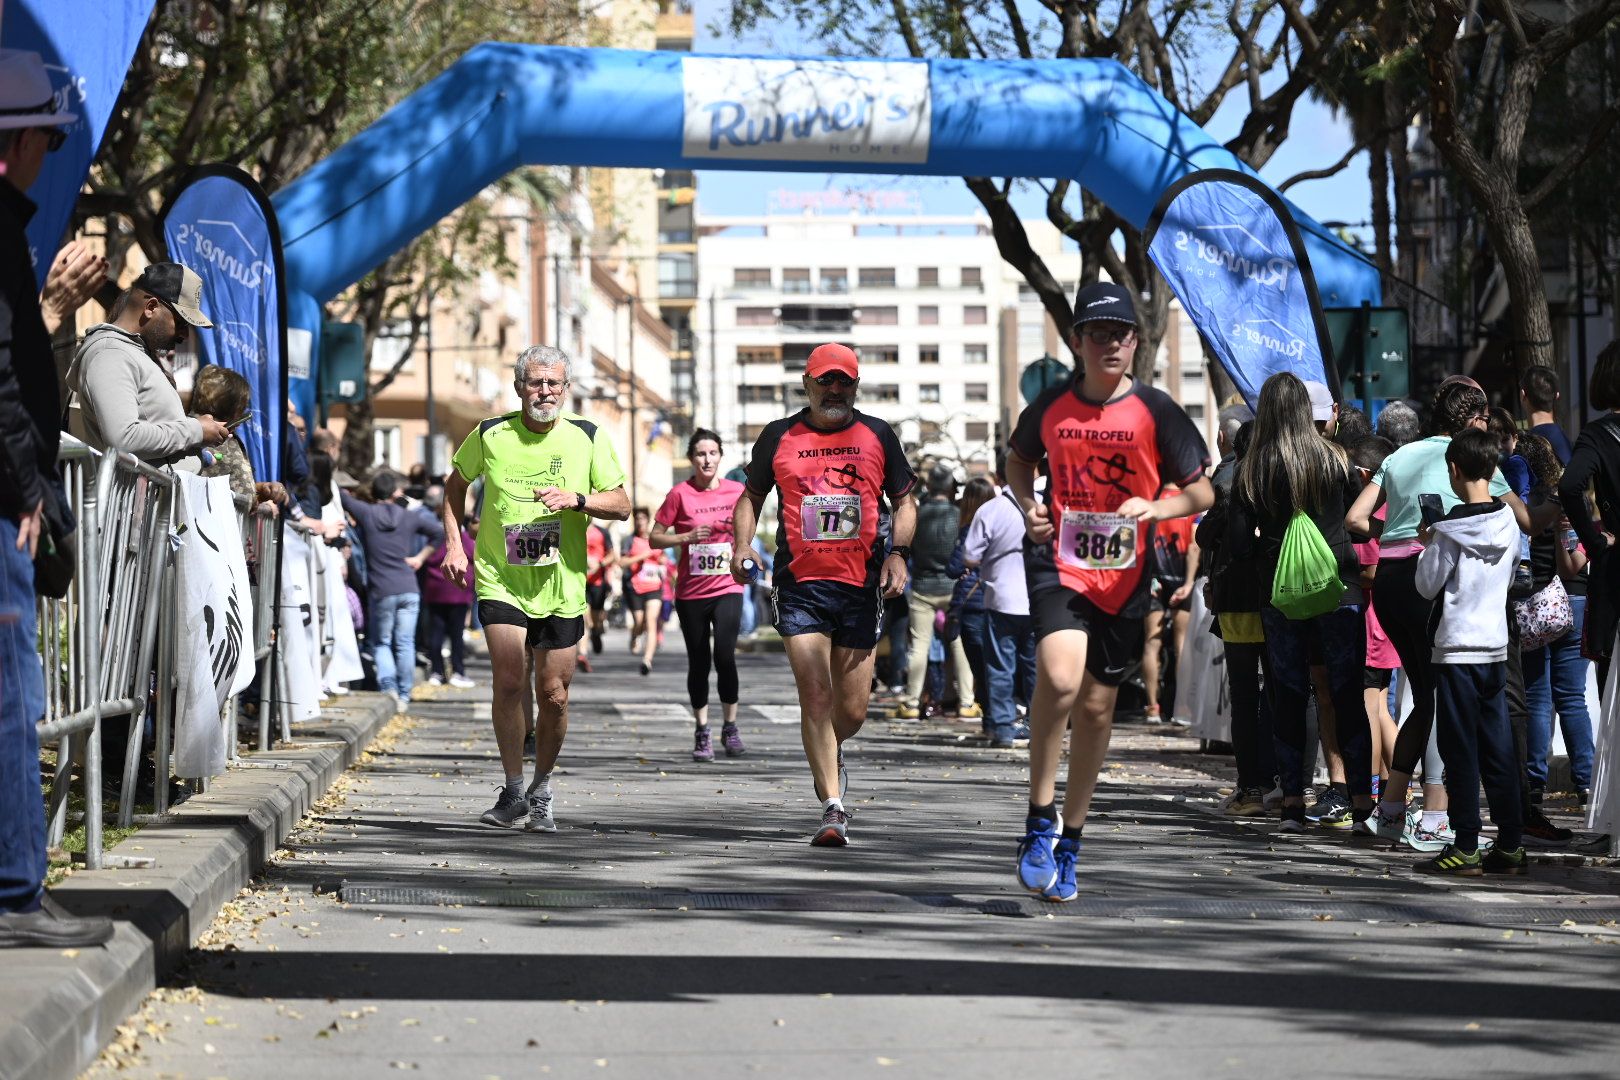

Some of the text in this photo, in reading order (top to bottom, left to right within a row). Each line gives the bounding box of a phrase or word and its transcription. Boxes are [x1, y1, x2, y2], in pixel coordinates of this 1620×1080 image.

[703, 92, 910, 151] Runner's
[828, 143, 903, 155] HOME
[1058, 428, 1134, 442] XXII TROFEU
[797, 447, 860, 459] XXII TROFEU
[505, 477, 524, 485] SANT
[820, 511, 841, 532] 77
[515, 538, 551, 559] 394
[1074, 532, 1121, 560] 384
[698, 555, 724, 570] 392
